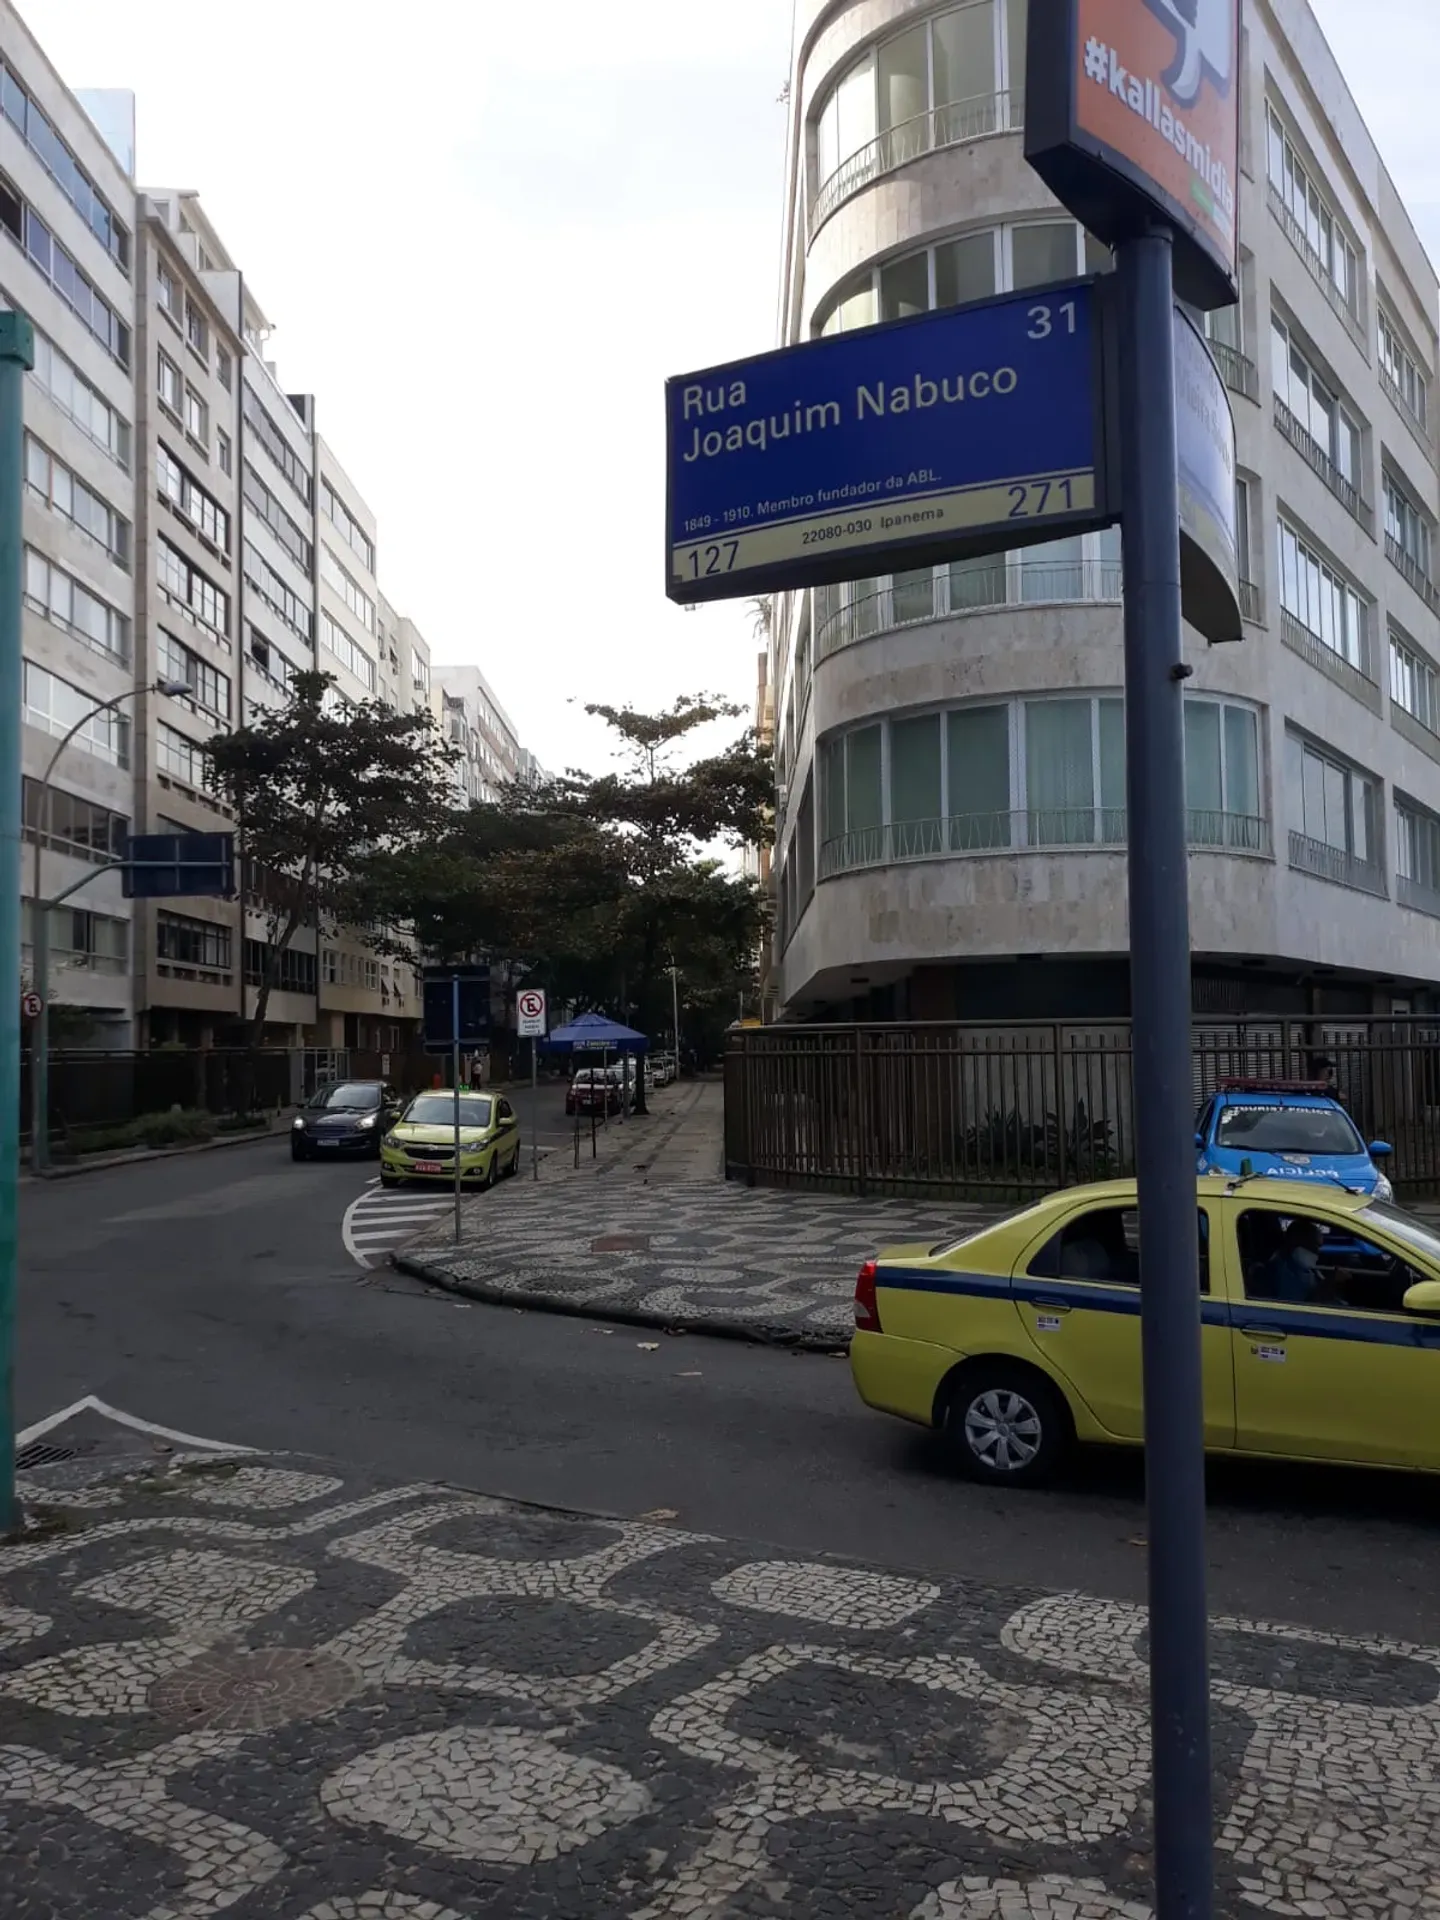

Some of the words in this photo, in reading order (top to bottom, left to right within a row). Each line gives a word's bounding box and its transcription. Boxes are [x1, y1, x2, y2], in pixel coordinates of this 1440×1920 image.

[1085, 36, 1233, 216] #kallasmidia
[1027, 301, 1076, 339] 31
[683, 380, 747, 420] Rua
[683, 398, 841, 462] Joaquim
[857, 366, 1018, 420] Nabuco
[683, 515, 712, 532] 1849
[723, 504, 754, 523] 1910.
[757, 493, 814, 514] Membro
[817, 479, 881, 503] fundador
[886, 476, 902, 490] da
[906, 468, 942, 487] ABL.
[1008, 478, 1074, 518] 271
[802, 519, 872, 544] 22080-030
[880, 509, 944, 530] Ipanema
[688, 541, 740, 578] 127
